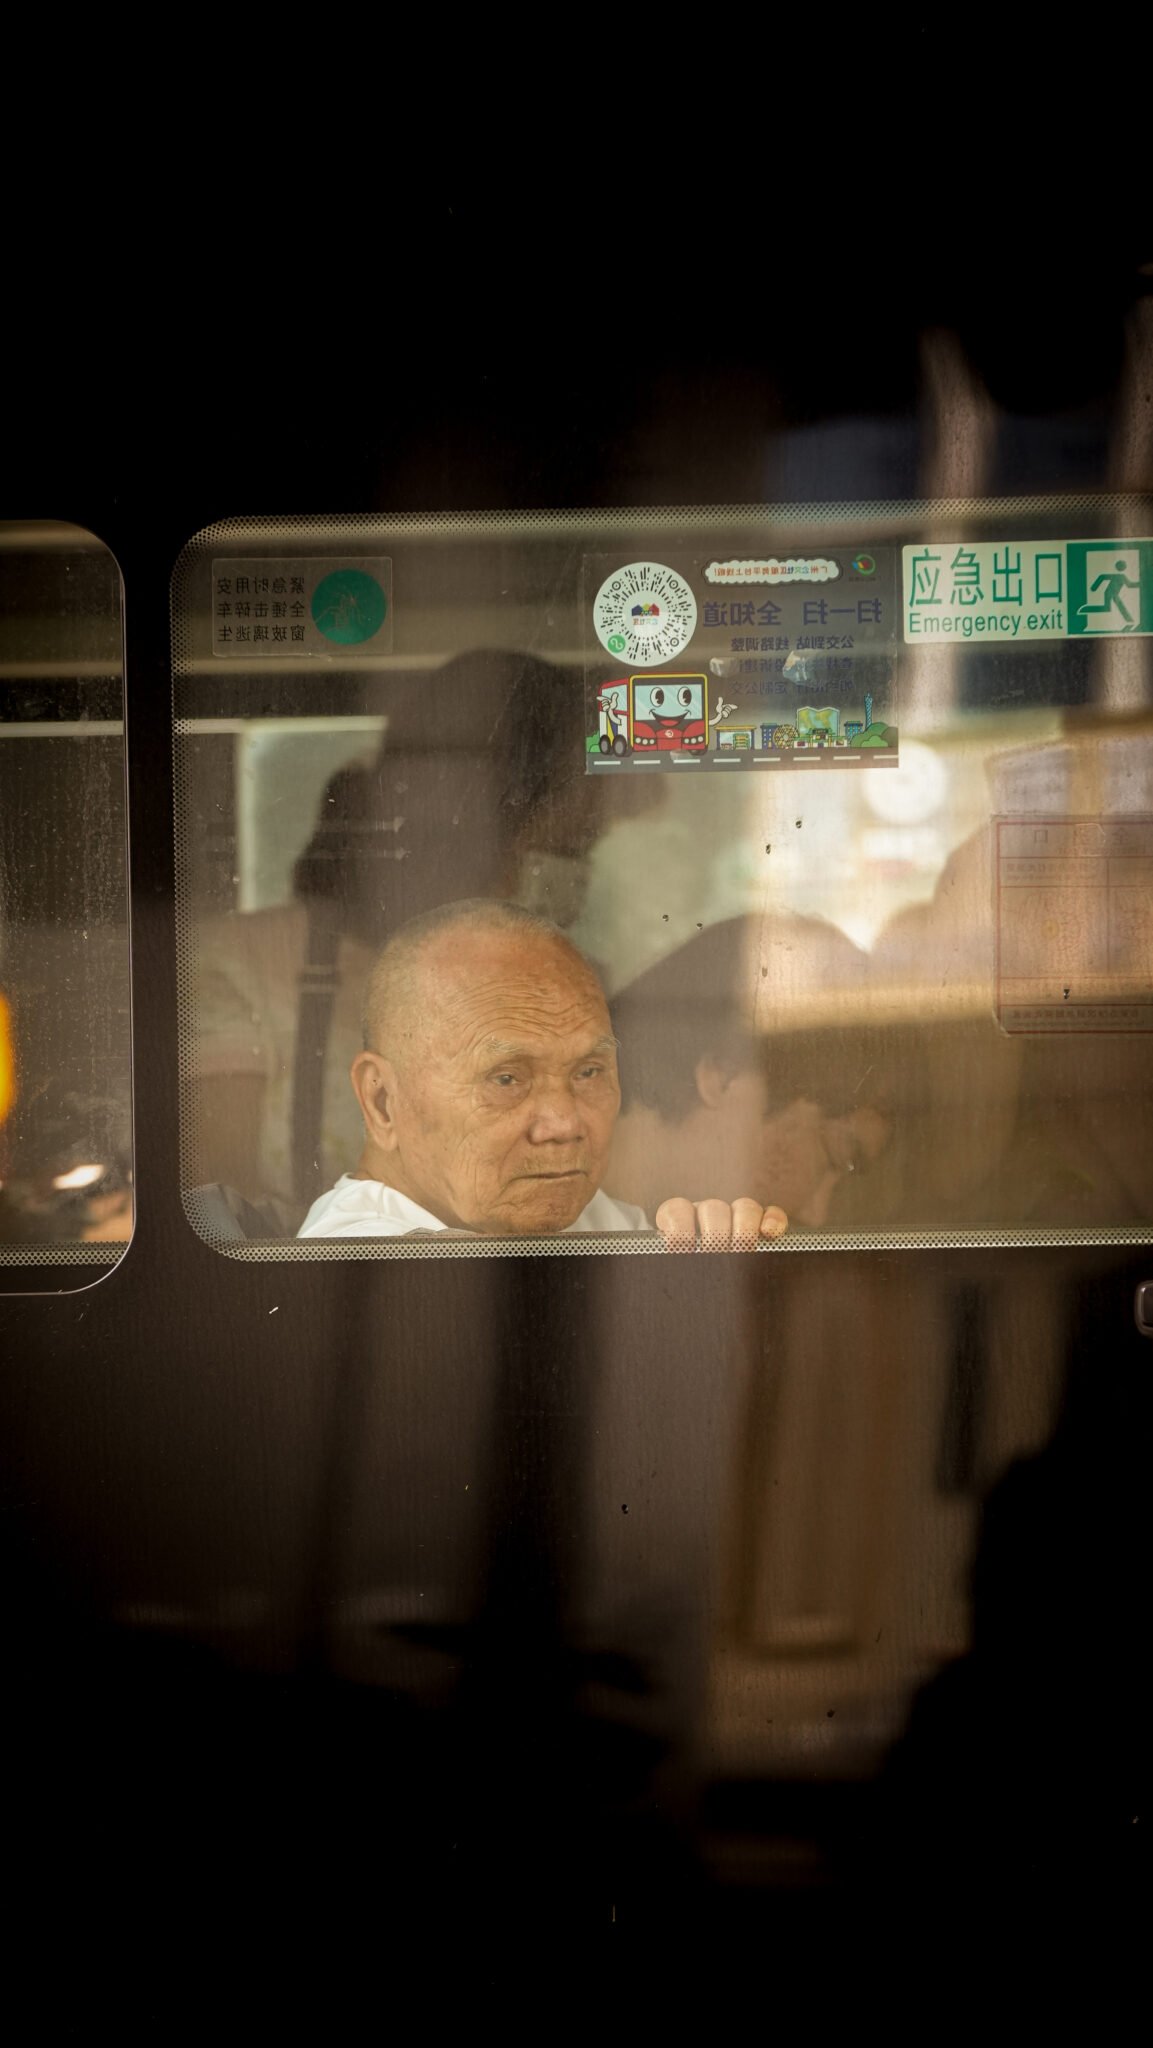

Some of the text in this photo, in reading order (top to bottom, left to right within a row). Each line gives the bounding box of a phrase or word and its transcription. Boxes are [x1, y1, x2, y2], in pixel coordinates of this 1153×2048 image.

[908, 546, 1063, 608] 应急出口
[909, 610, 1063, 637] Emergency exit
